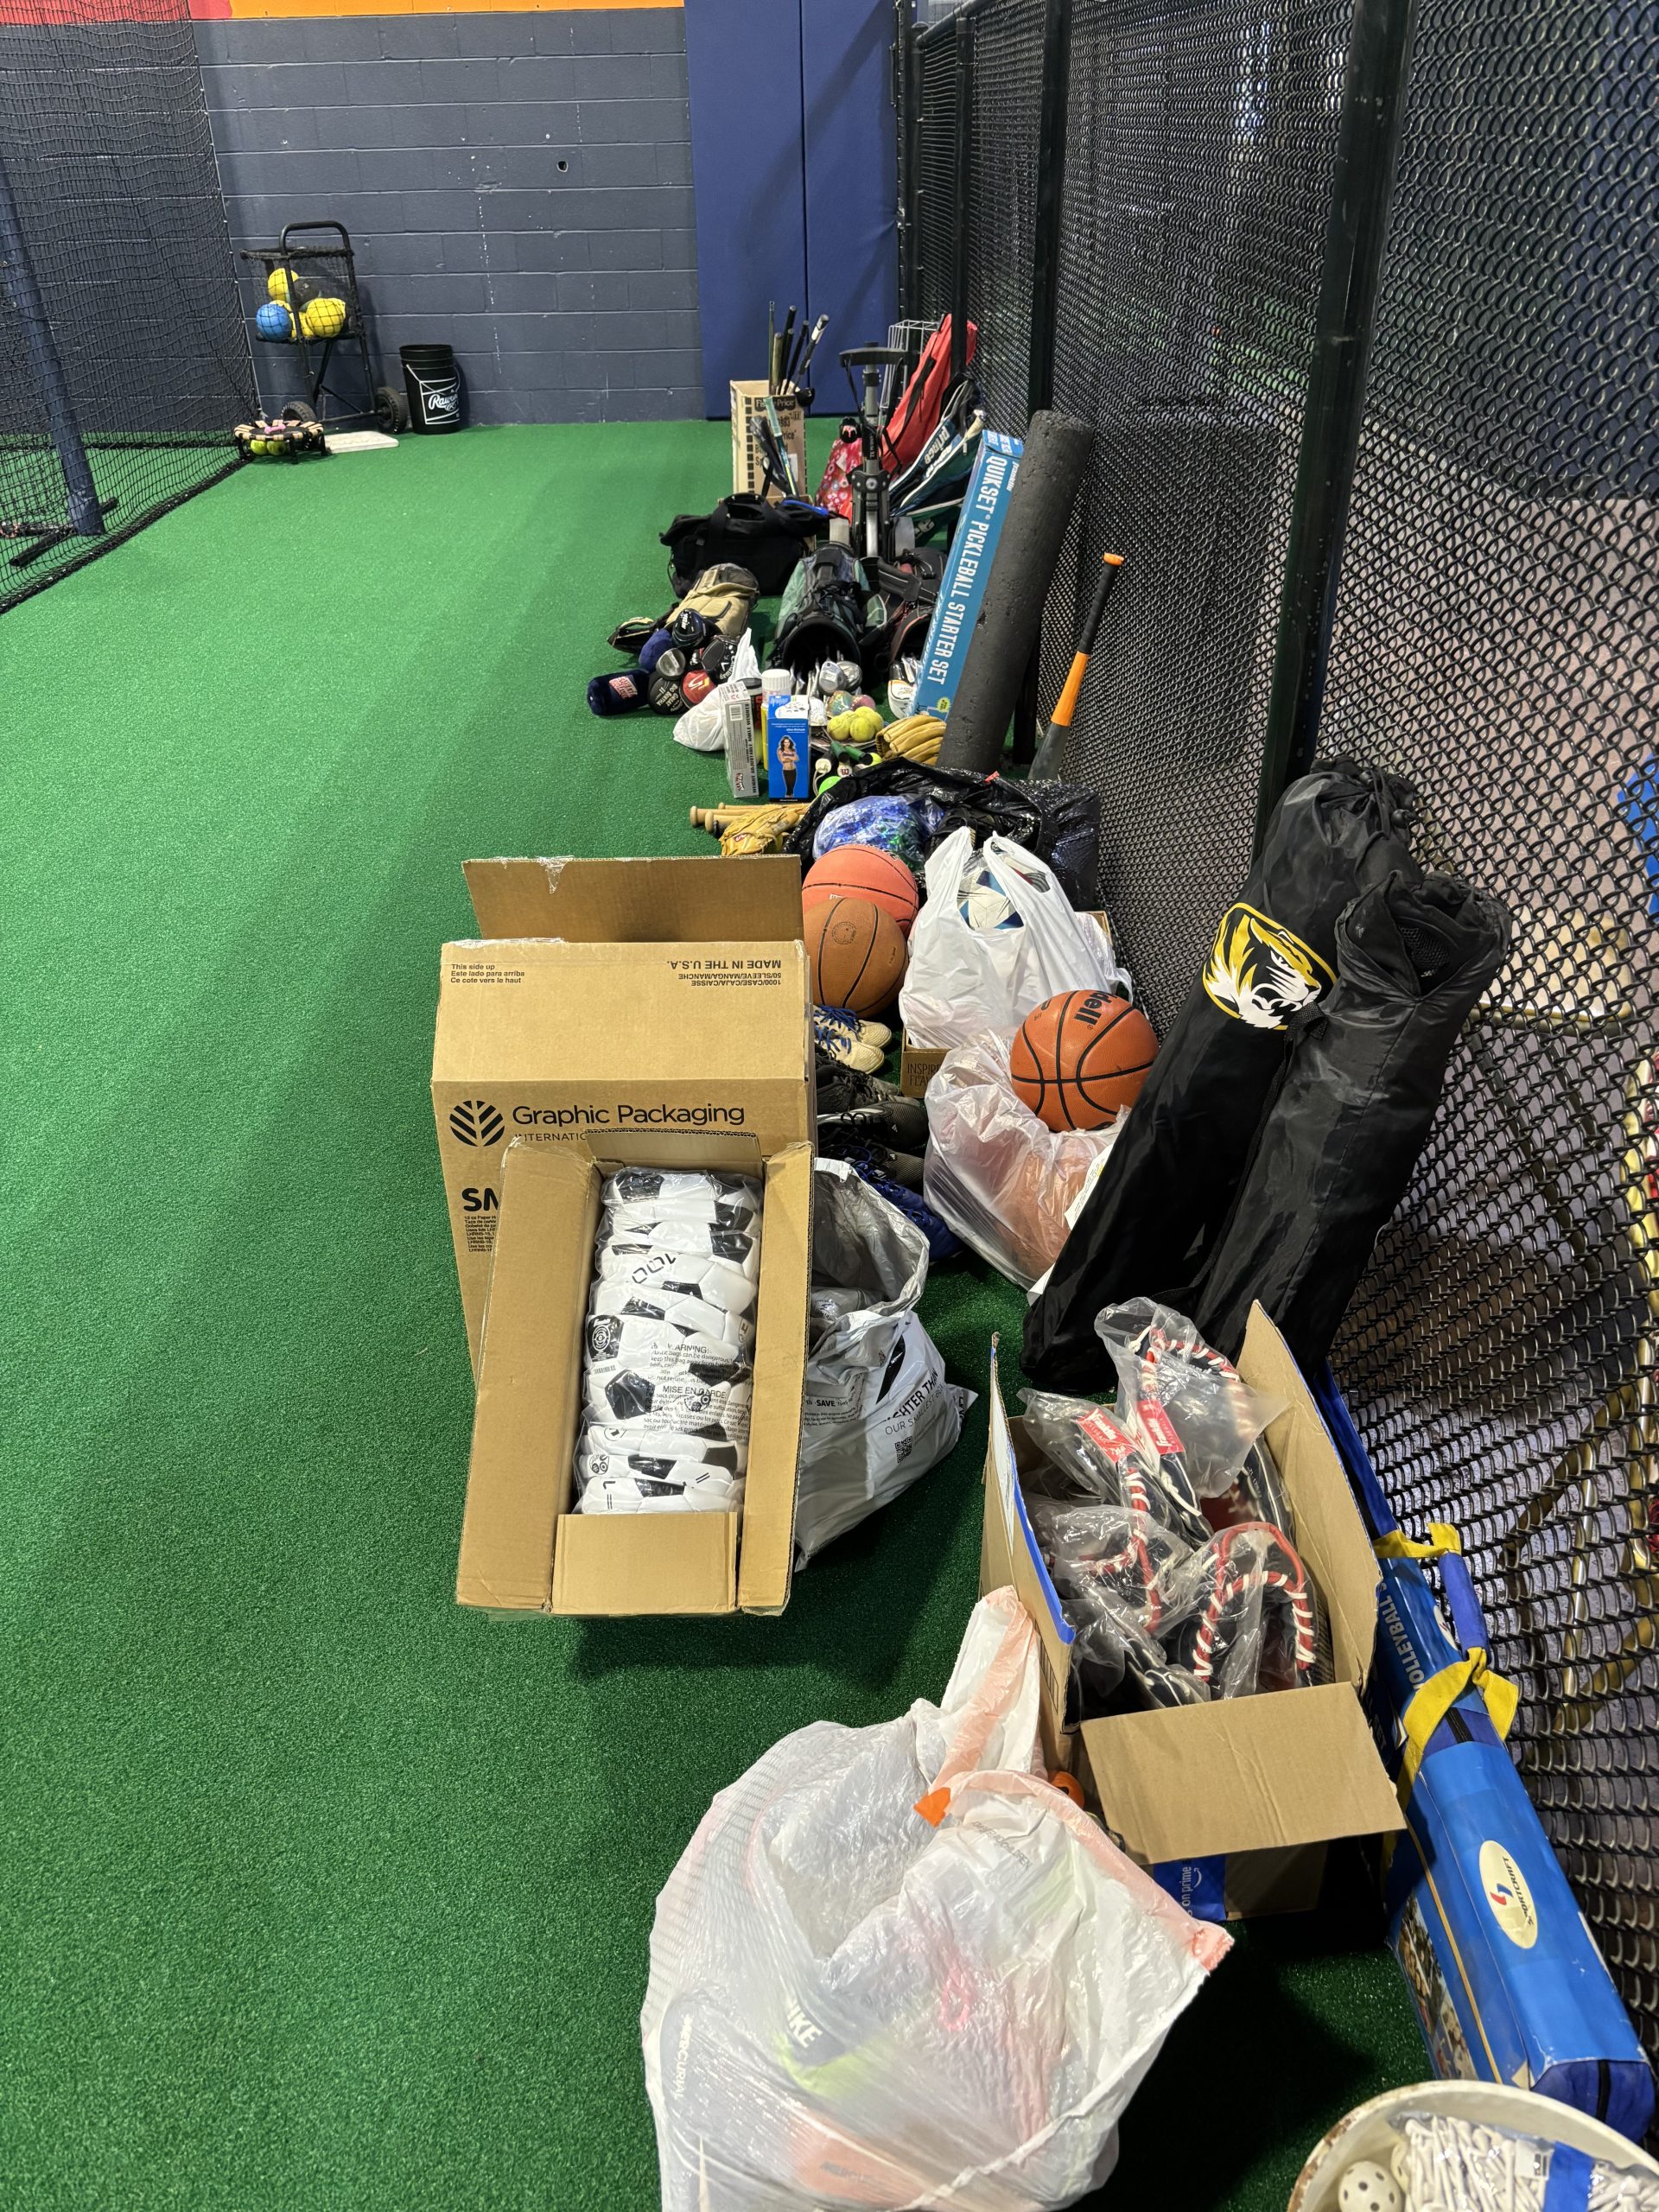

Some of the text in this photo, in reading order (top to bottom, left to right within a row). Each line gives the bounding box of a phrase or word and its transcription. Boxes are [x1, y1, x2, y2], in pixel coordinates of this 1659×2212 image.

[950, 519, 990, 598] PICKLEBALL
[933, 602, 966, 658] STARTER
[926, 659, 950, 685] SET
[666, 960, 782, 970] MADE IN THE U.S.A.
[512, 1103, 745, 1130] Graphic Packaging
[663, 1385, 683, 1394] MISE
[684, 1386, 696, 1395] EN
[817, 1399, 836, 1408] SAVE
[885, 1421, 906, 1435] OUR
[907, 1394, 935, 1427] SMALLEST
[1181, 1866, 1194, 1893] prime
[1502, 1856, 1535, 1925] SPORTCRAFT
[1181, 1895, 1191, 1907] on
